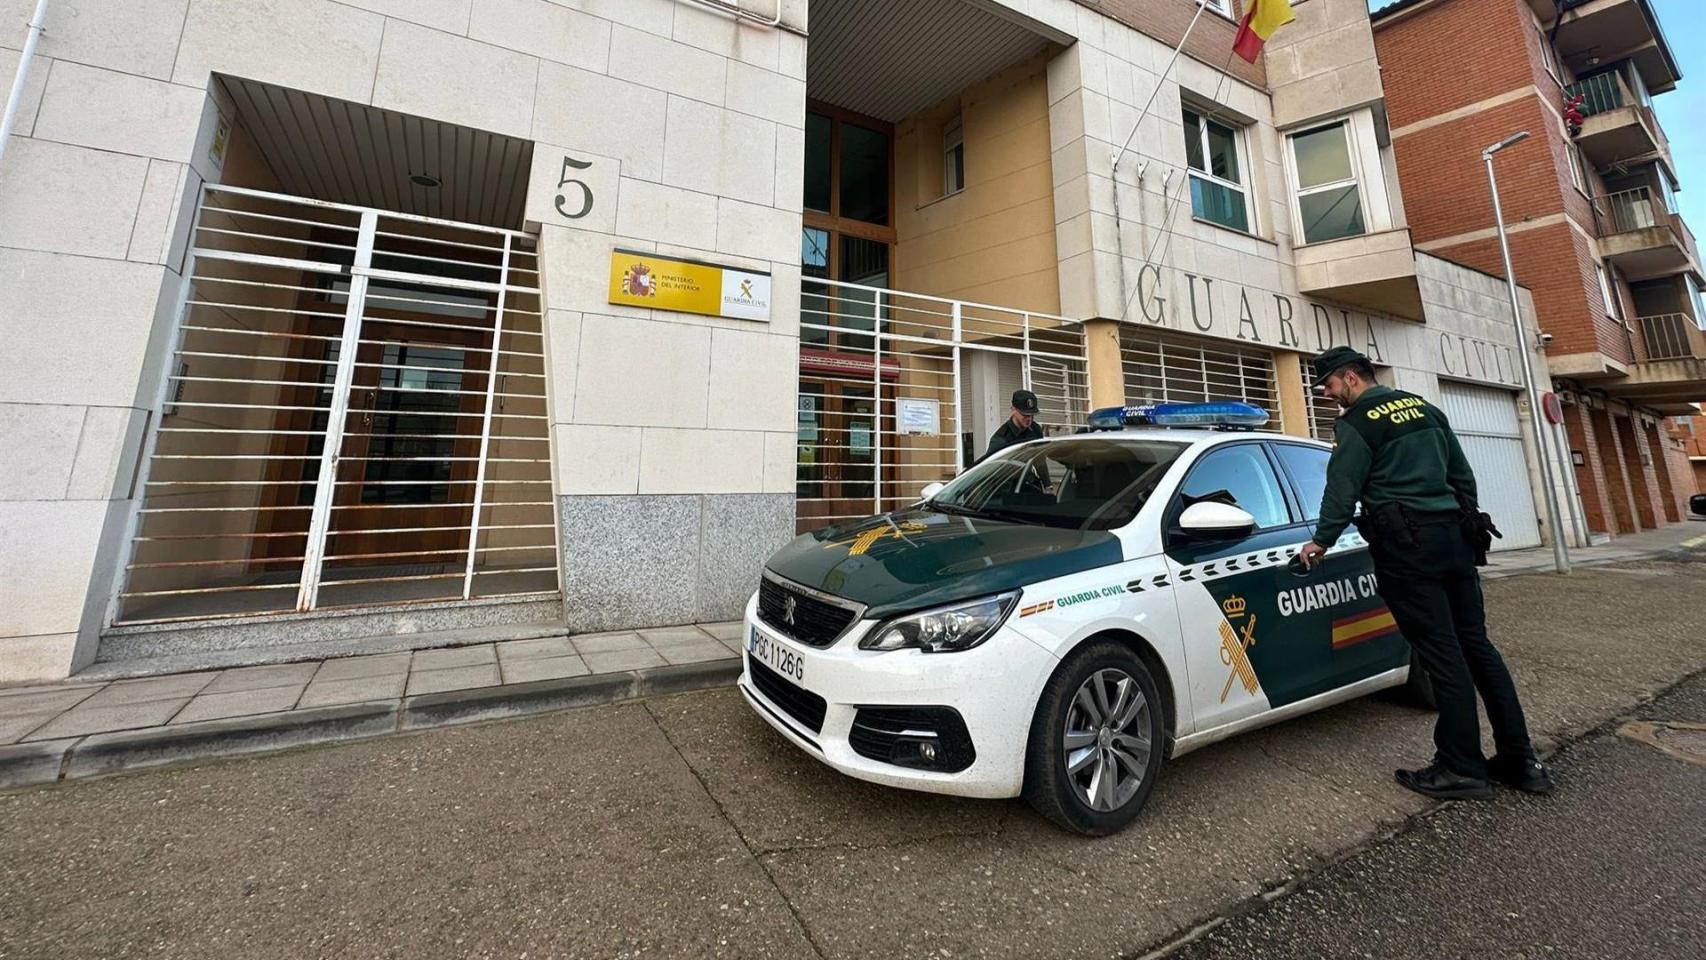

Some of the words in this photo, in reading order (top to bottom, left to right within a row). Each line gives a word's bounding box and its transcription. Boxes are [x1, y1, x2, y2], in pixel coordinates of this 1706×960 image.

[555, 156, 593, 218] 5
[662, 275, 694, 284] MINISTERIO
[674, 283, 700, 291] INTERIOR
[1138, 264, 1383, 363] GUARDIA
[1441, 332, 1521, 386] CIVIL
[1367, 397, 1425, 419] GUARDIA
[1390, 408, 1424, 424] CIVIL
[1057, 590, 1101, 607] GUARDIA
[1101, 585, 1126, 597] CIVIL
[1278, 579, 1357, 617] GUARDIA
